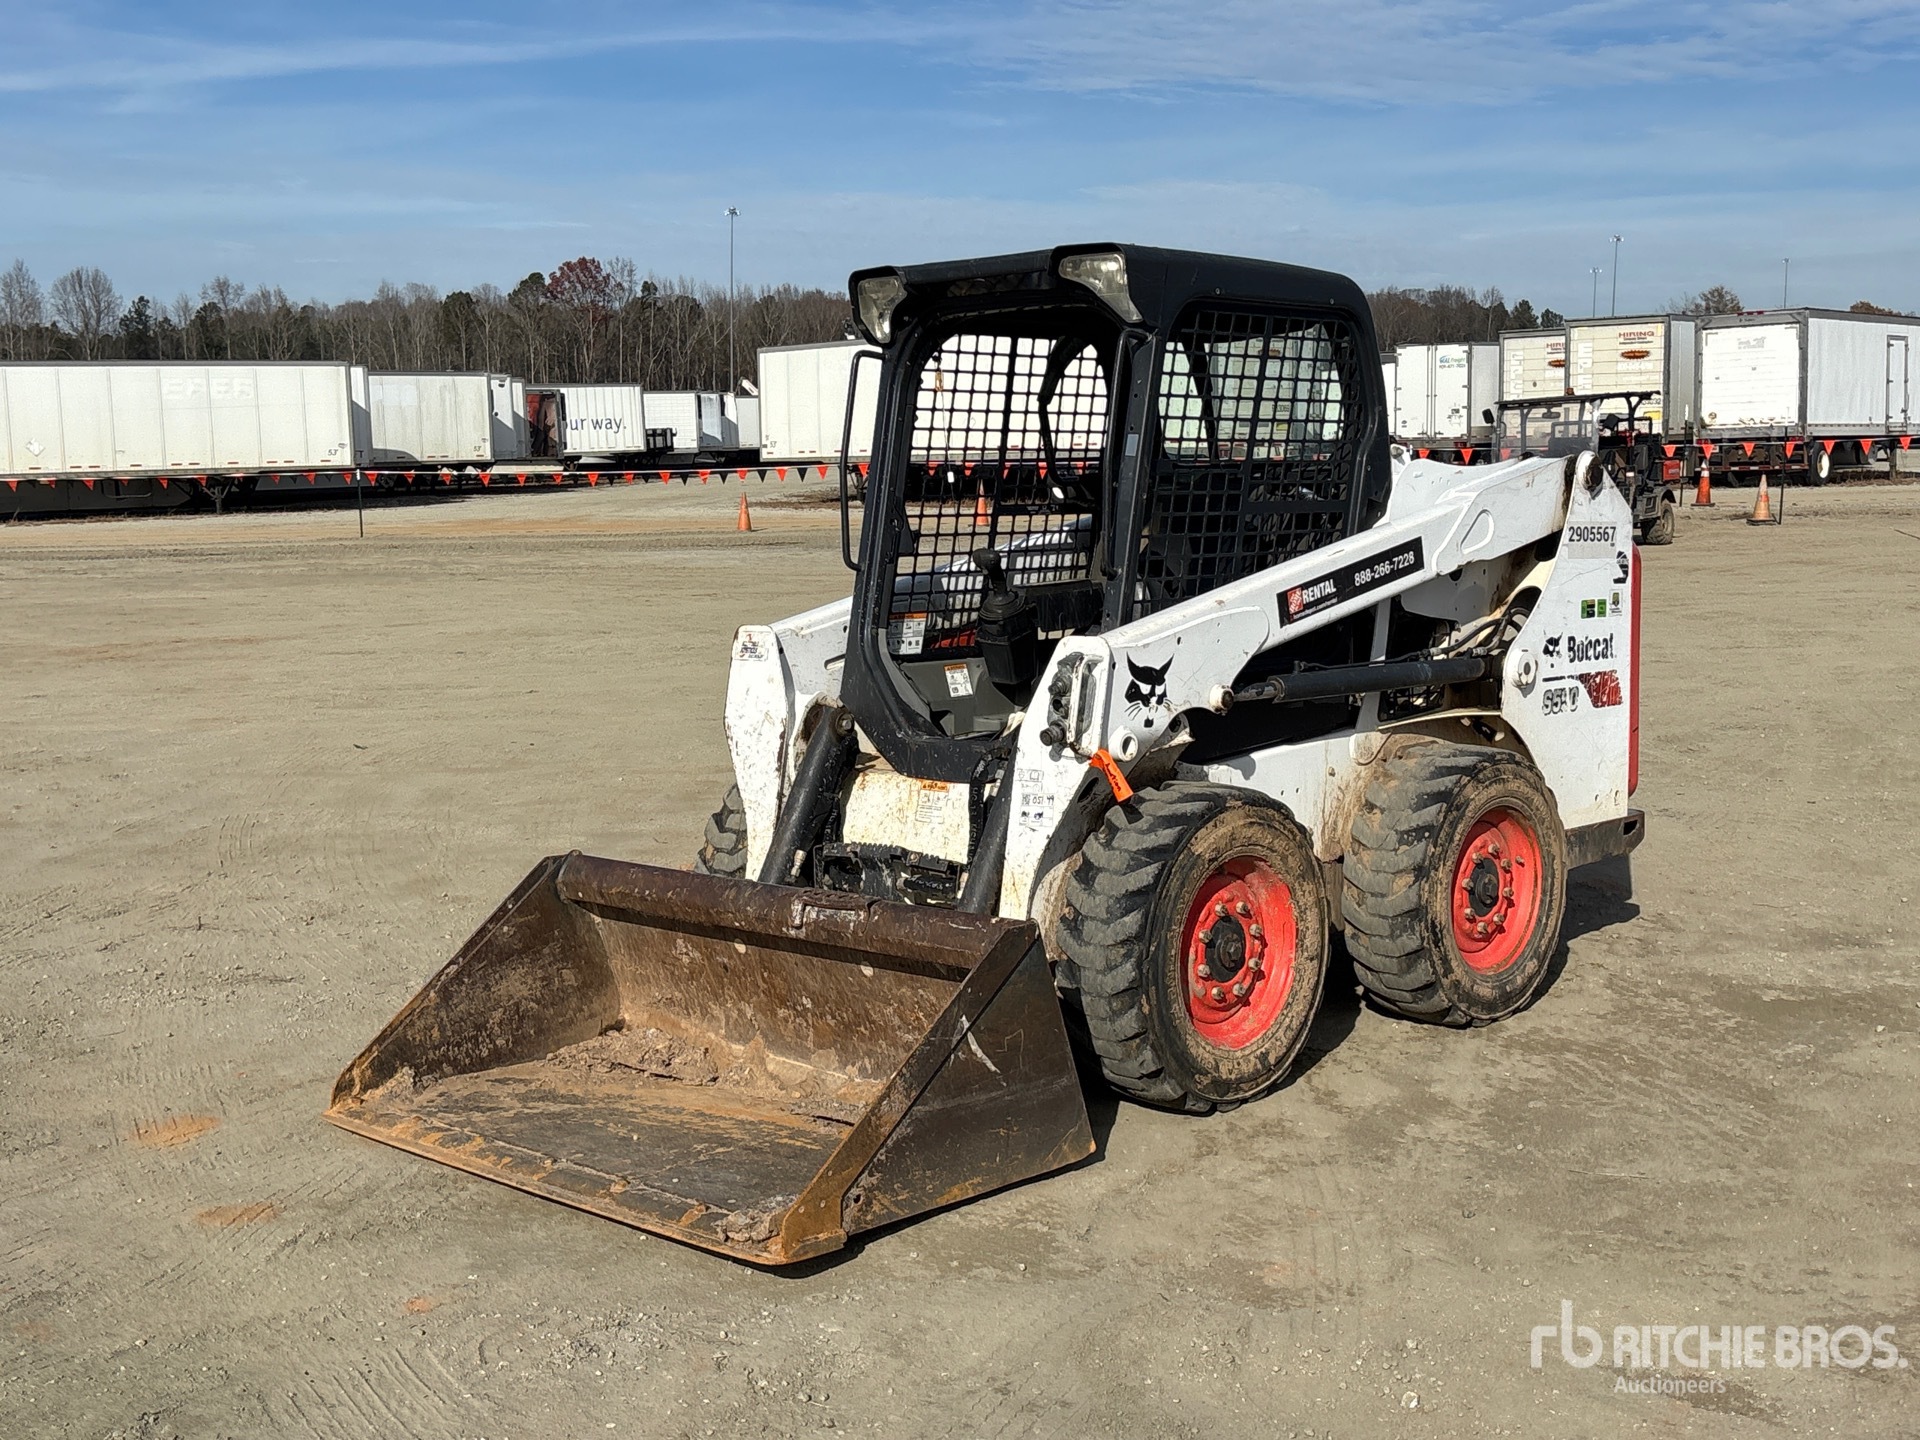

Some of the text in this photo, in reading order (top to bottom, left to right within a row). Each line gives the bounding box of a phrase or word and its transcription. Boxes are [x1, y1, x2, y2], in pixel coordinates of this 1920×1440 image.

[1619, 330, 1655, 338] HIRING
[591, 418, 627, 434] way.
[1568, 526, 1617, 542] 2905567
[1302, 578, 1338, 605] RENTAL
[1354, 550, 1415, 587] 888-266-7228
[1567, 633, 1614, 663] Bobcat
